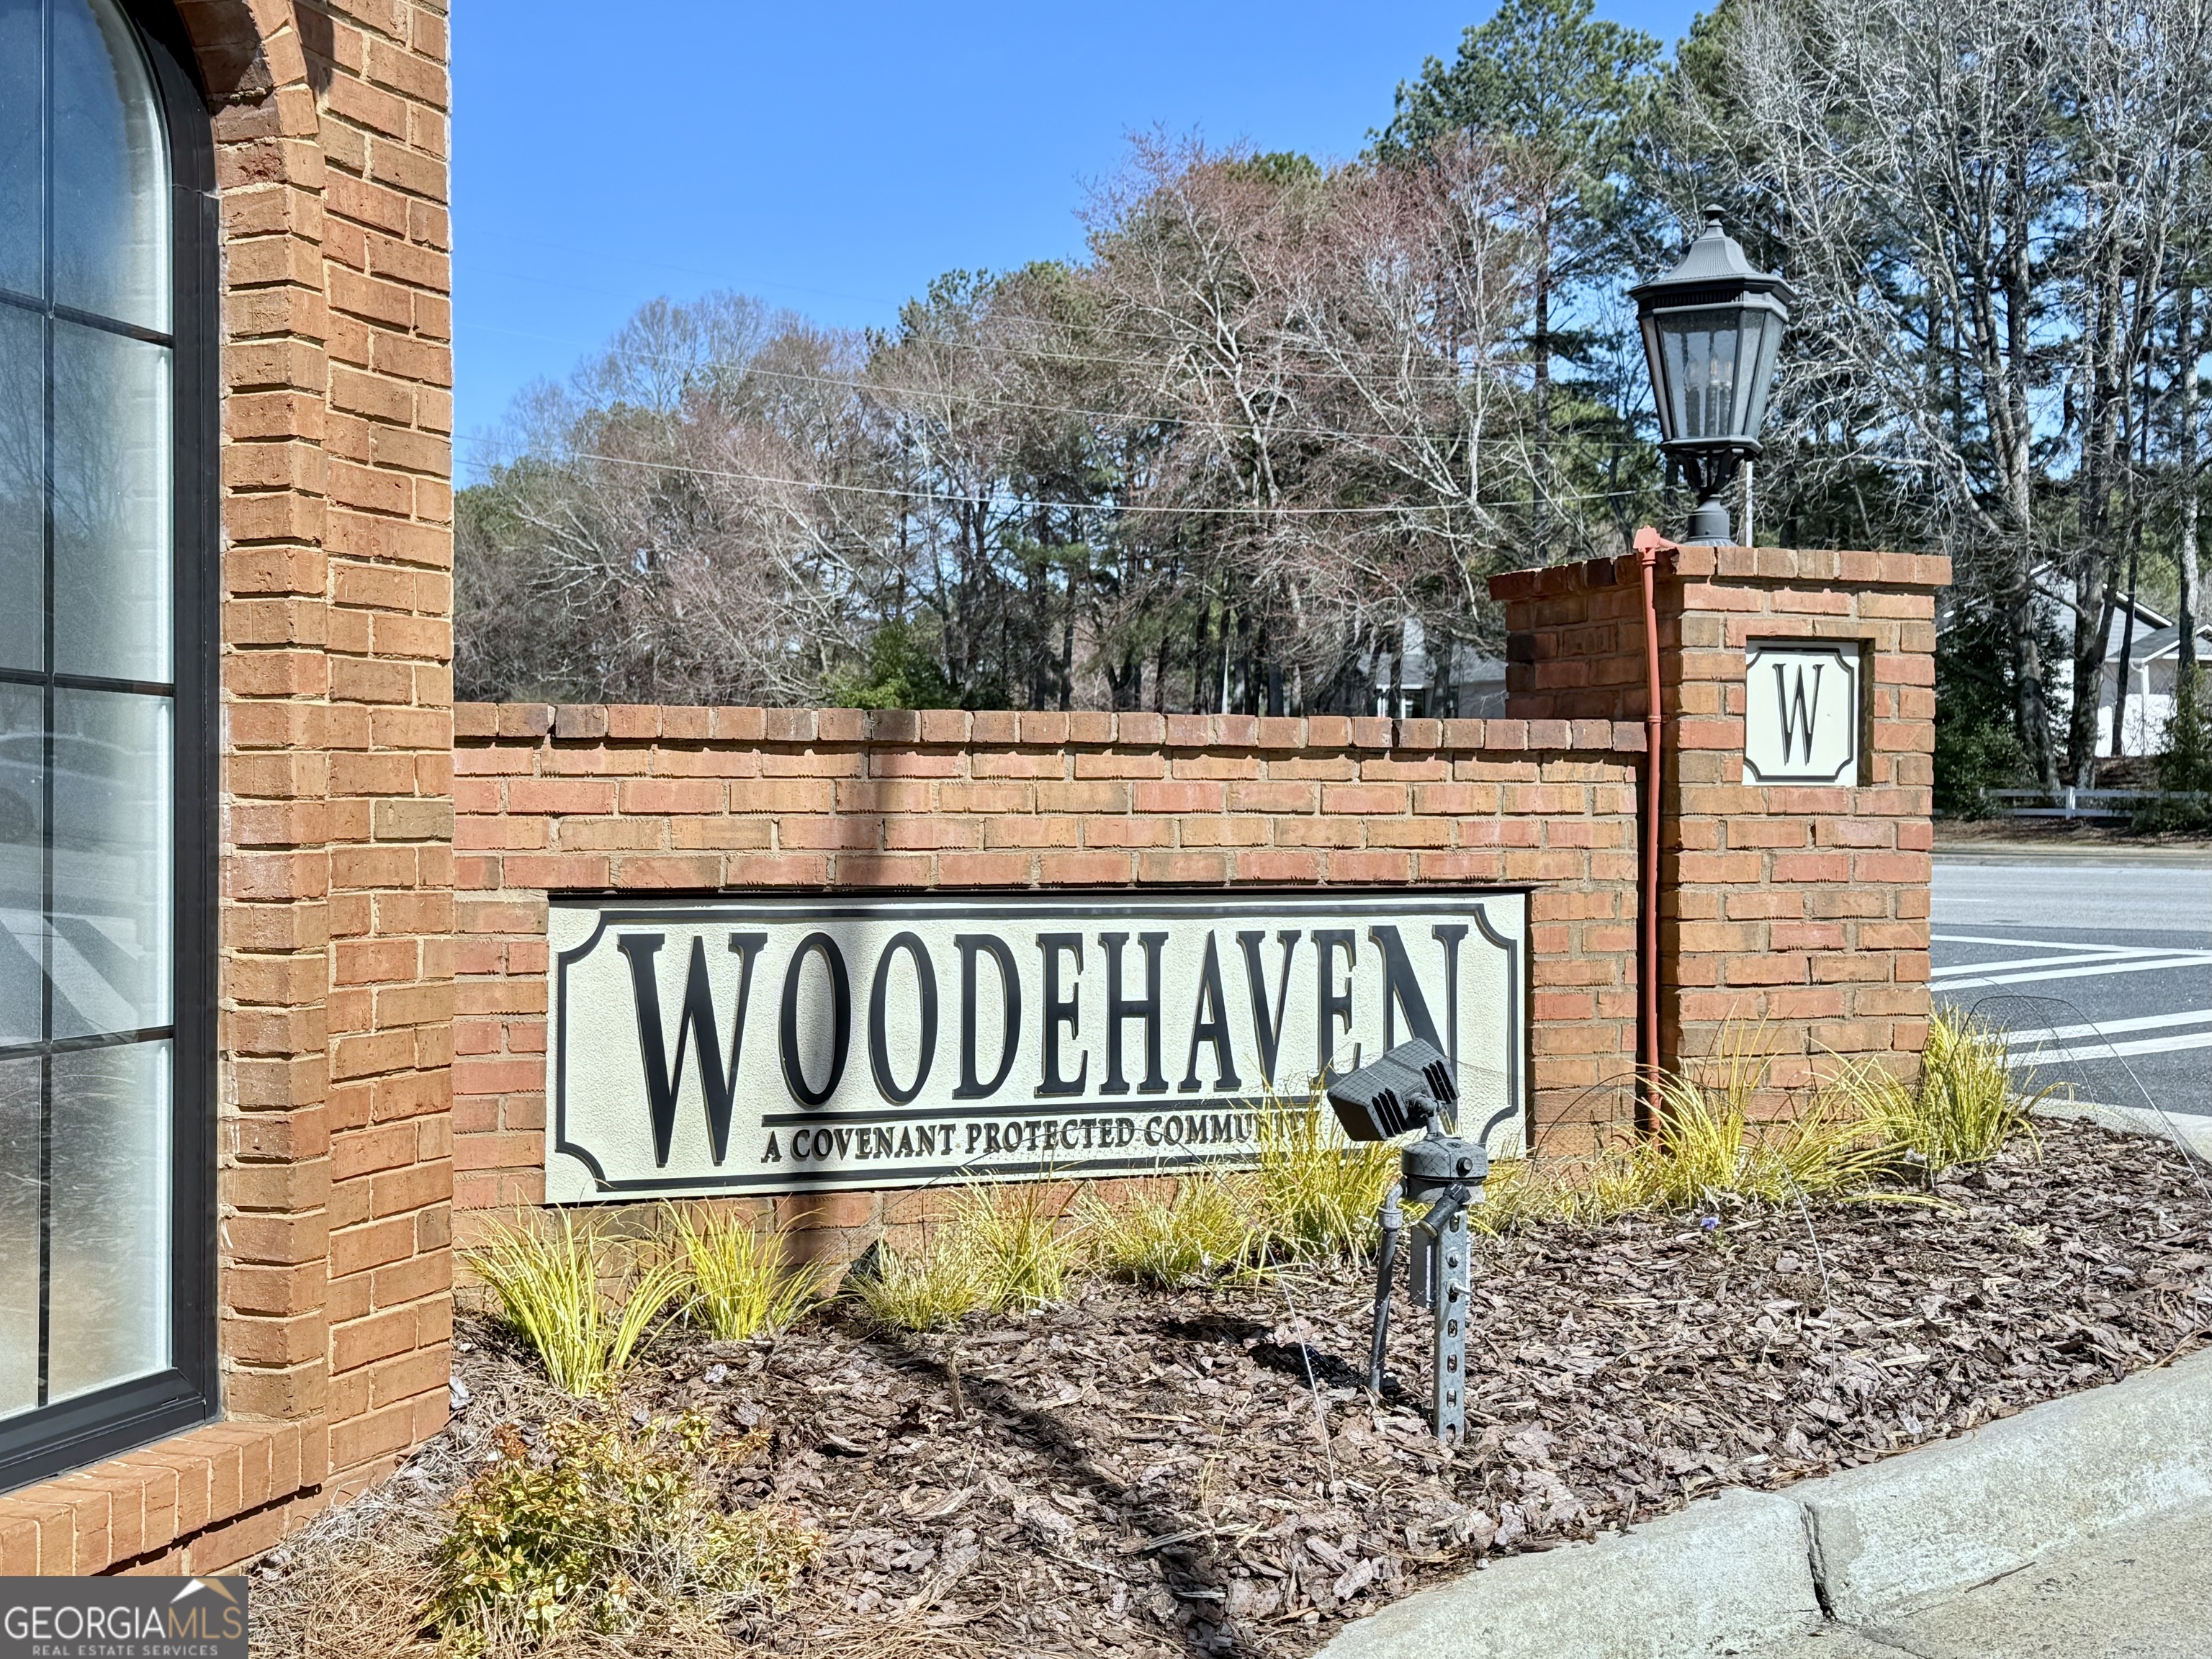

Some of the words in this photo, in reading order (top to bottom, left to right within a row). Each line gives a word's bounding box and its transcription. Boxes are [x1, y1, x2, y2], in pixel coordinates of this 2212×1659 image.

[1772, 663, 1825, 766] W
[617, 924, 1469, 1168] WOODEHAVEN
[761, 1130, 782, 1163] A
[791, 1123, 956, 1161] COVENANT
[966, 1118, 1136, 1153] PROTECTED
